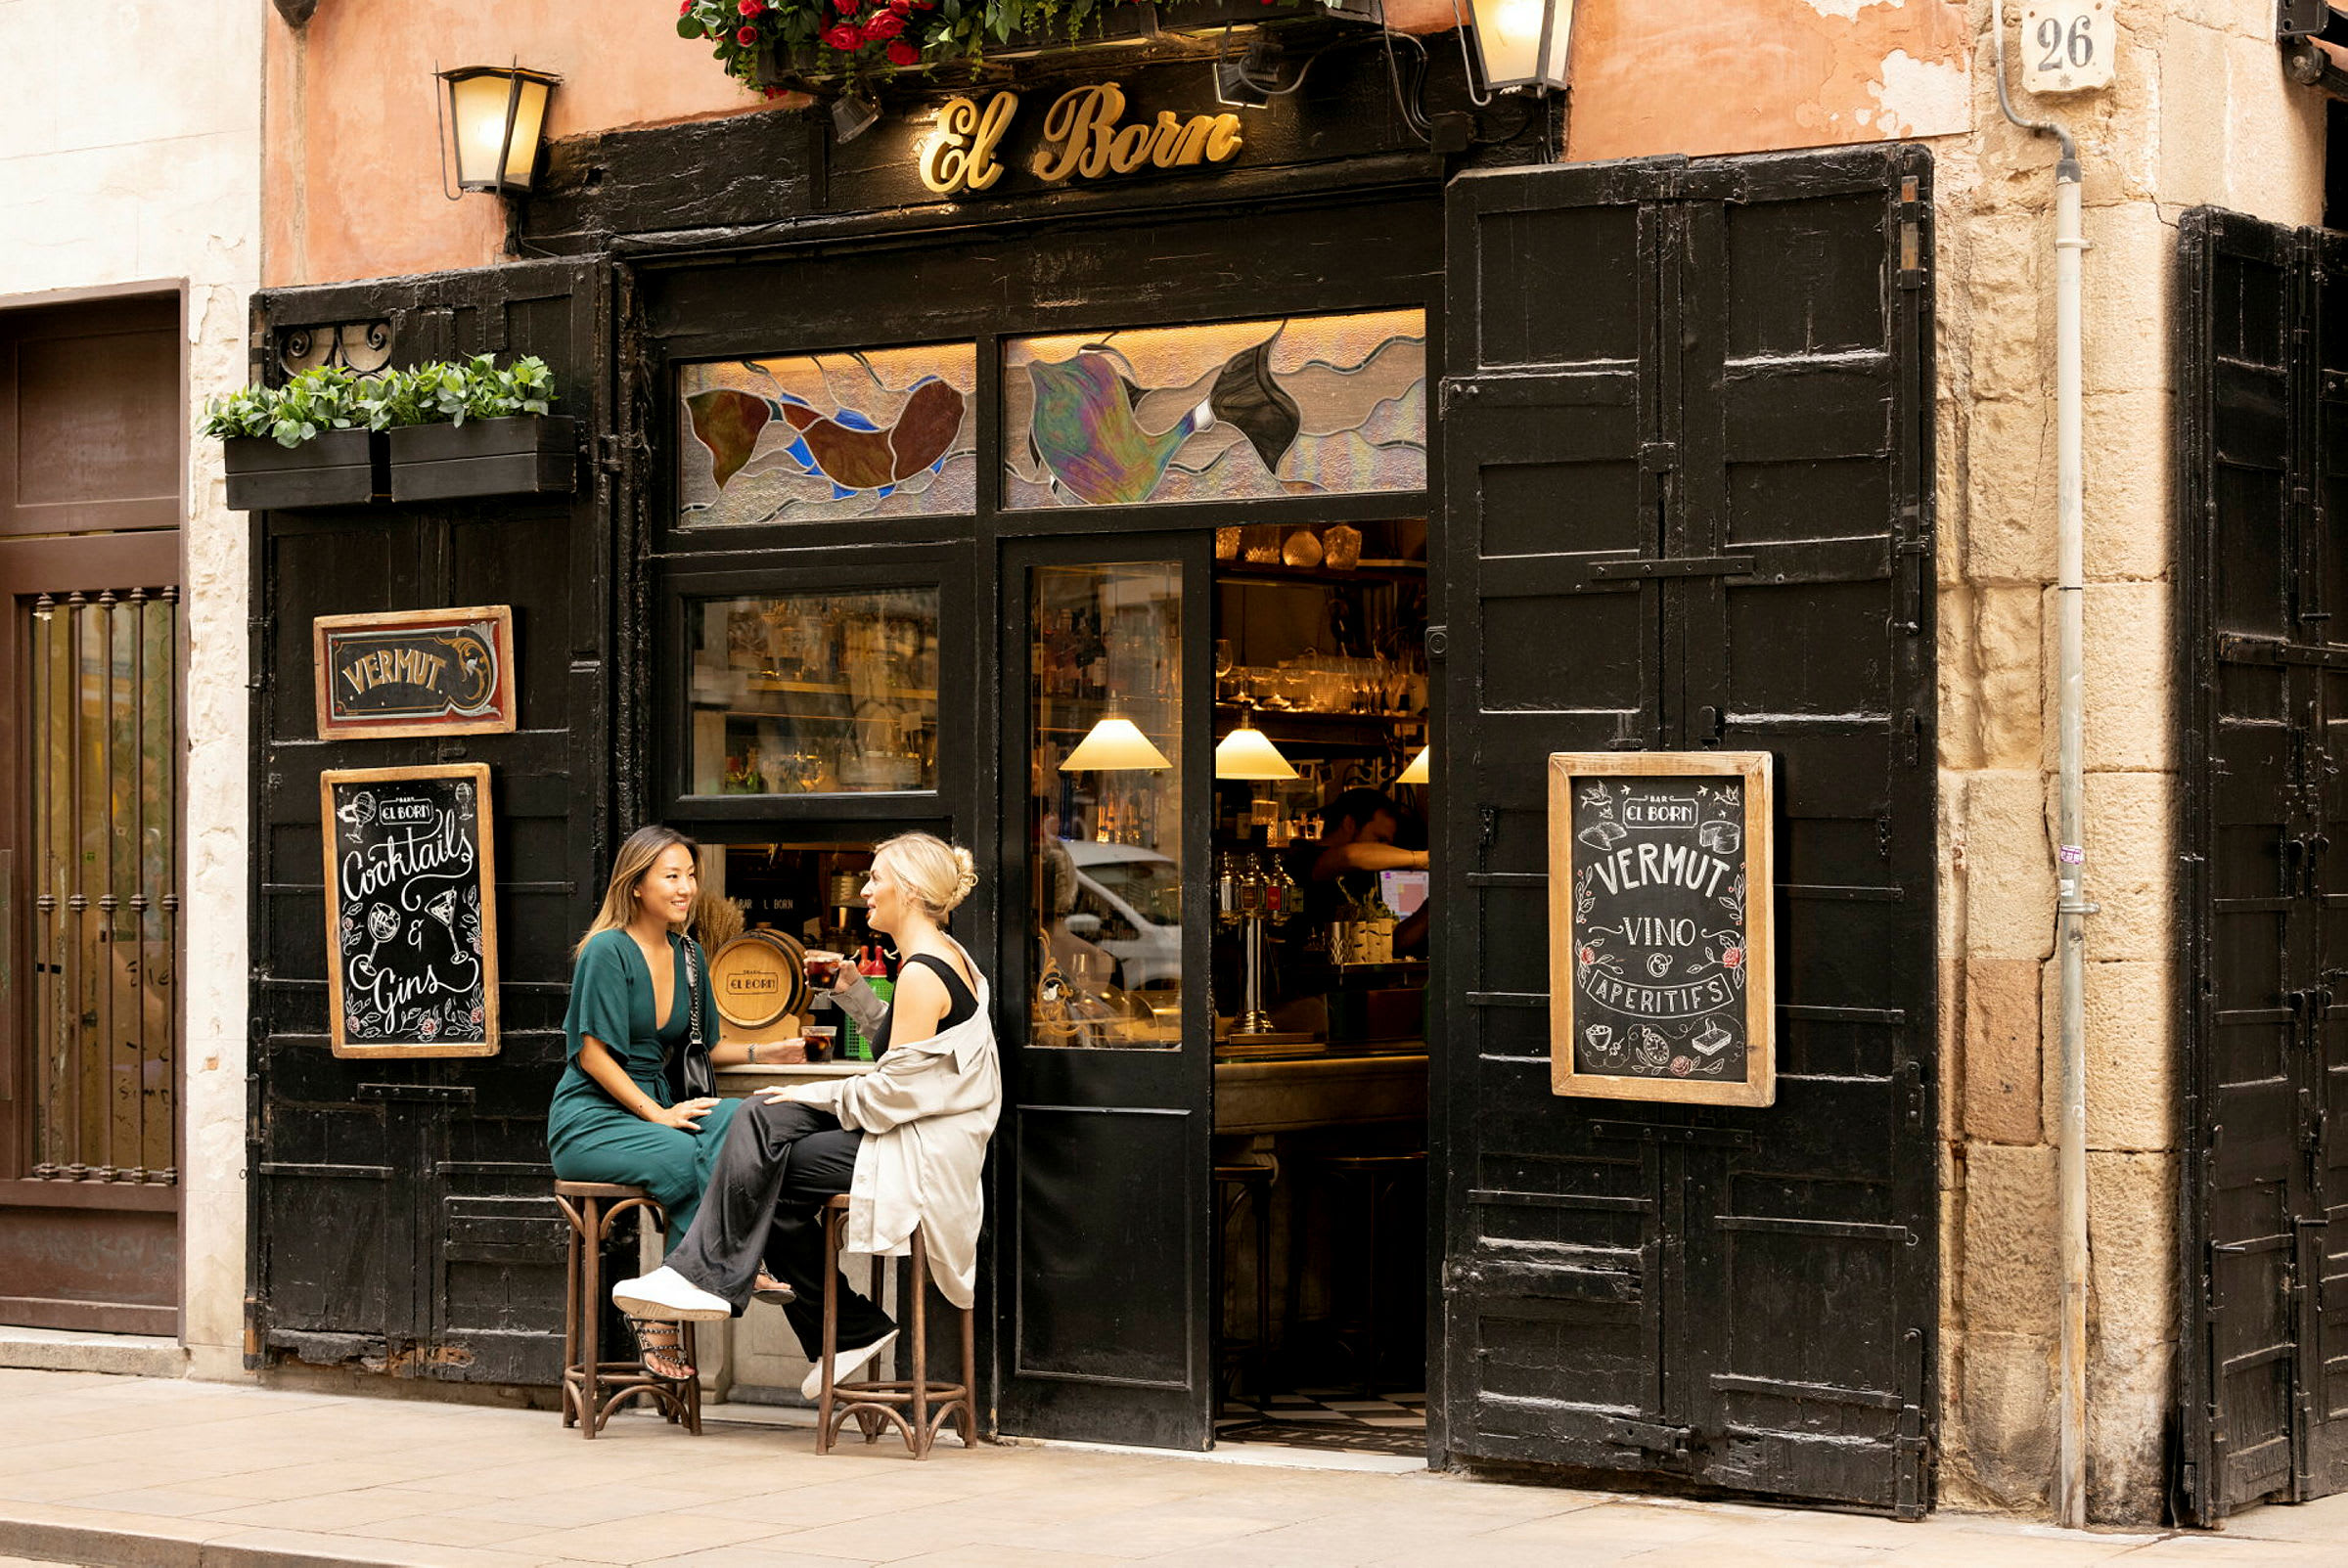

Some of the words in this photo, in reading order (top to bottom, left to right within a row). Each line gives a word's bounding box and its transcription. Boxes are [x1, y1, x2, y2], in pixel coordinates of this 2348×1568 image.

[2037, 15, 2094, 72] 26
[919, 90, 1019, 194] El
[1033, 81, 1243, 182] Born
[342, 649, 446, 694] VERMUT
[382, 807, 396, 820] EL
[397, 804, 430, 820] BORN
[1648, 805, 1692, 822] BORN
[342, 808, 474, 912] Cocktails
[1595, 843, 1730, 897] VERMUT
[1622, 917, 1696, 947] VINO
[731, 979, 742, 989] EL
[745, 979, 776, 989] BORN
[1594, 980, 1724, 1013] APERITIFS
